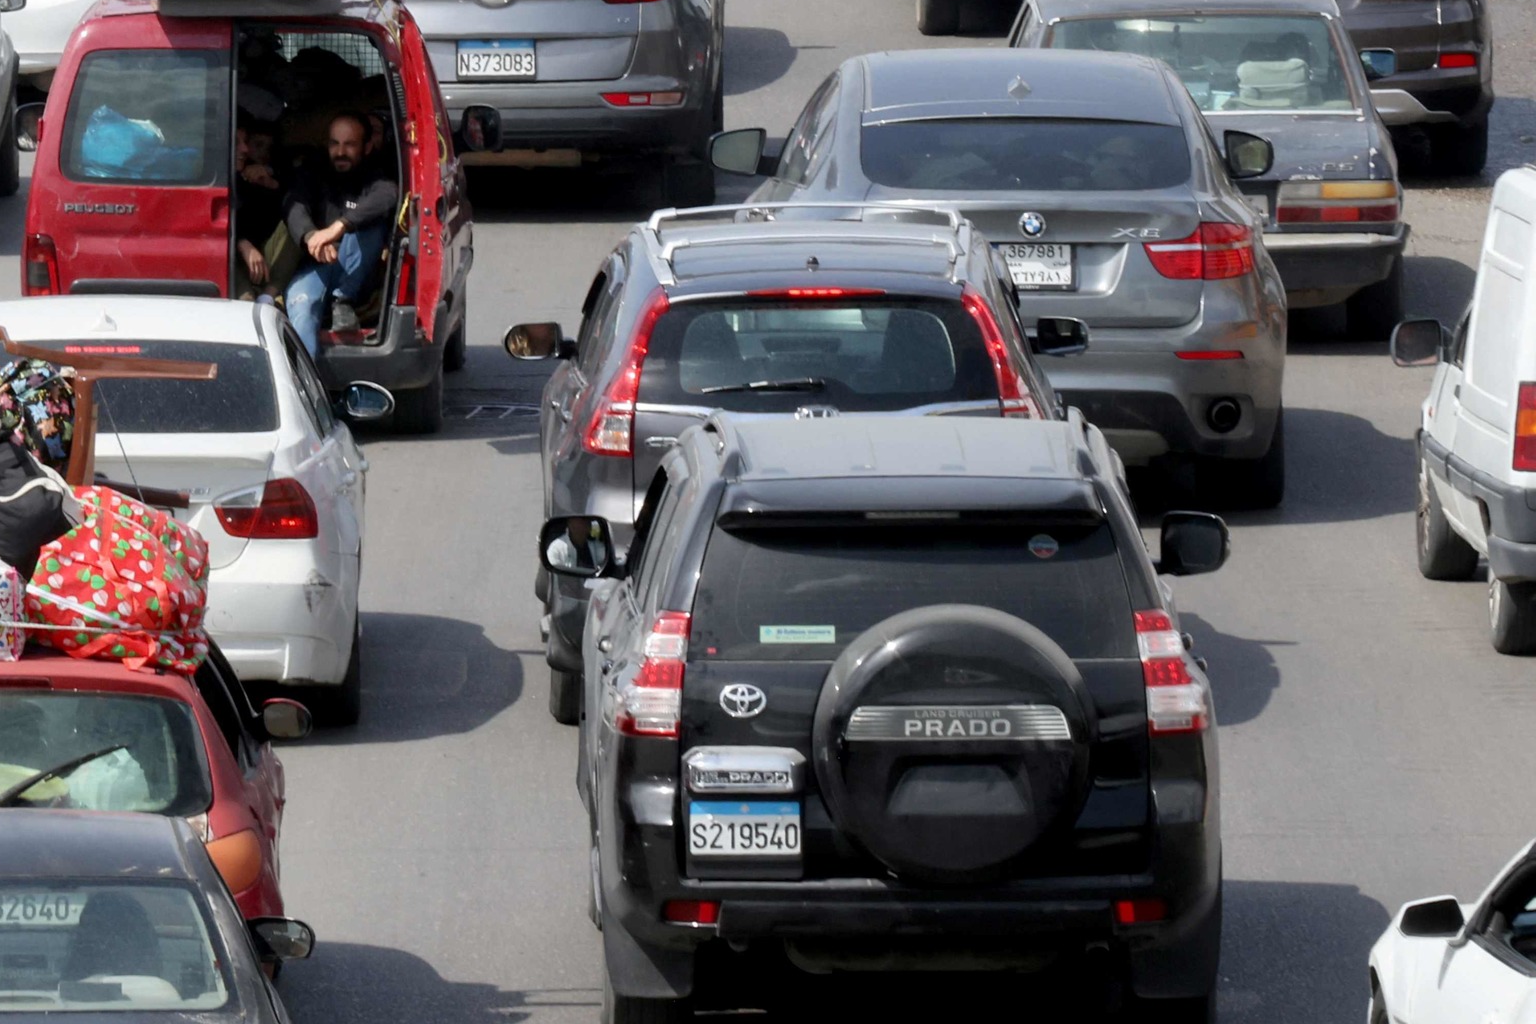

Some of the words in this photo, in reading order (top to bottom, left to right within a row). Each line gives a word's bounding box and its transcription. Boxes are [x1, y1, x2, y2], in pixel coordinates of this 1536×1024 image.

[460, 54, 534, 73] N373083
[64, 203, 135, 215] PEUGEOT
[1004, 245, 1064, 259] 367981
[914, 710, 947, 718] LAND
[949, 709, 1001, 718] CRUISER
[905, 719, 1011, 737] PRADO
[692, 822, 799, 850] S219540
